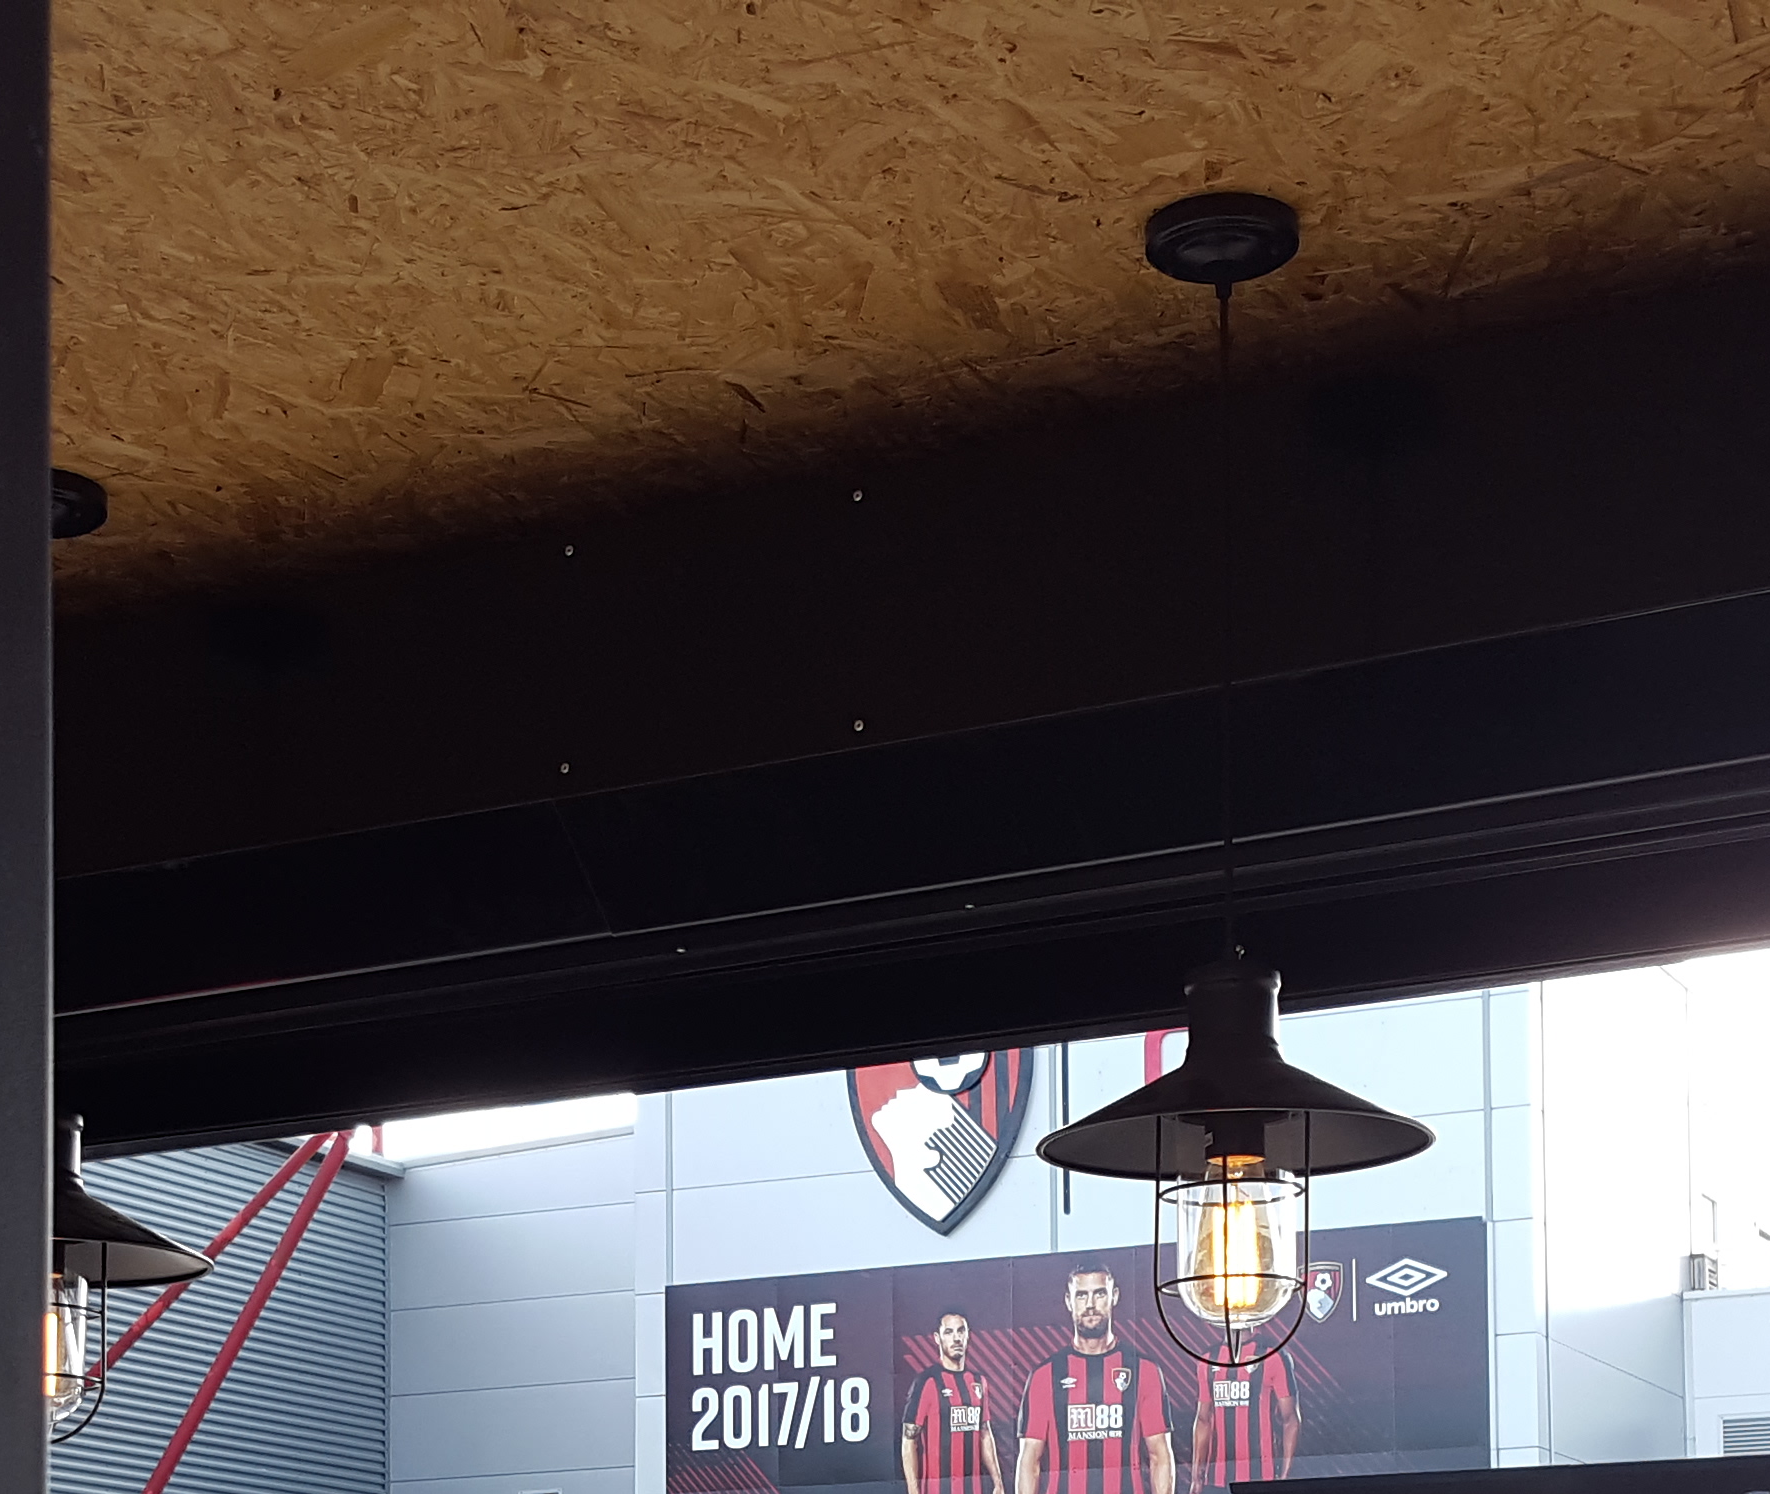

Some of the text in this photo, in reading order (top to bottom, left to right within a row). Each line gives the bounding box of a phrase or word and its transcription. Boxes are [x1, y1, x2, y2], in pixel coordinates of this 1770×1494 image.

[1374, 1297, 1440, 1316] umbro
[692, 1302, 837, 1376] HOME
[691, 1376, 870, 1451] 2017/18
[1067, 1430, 1108, 1441] MANSION
